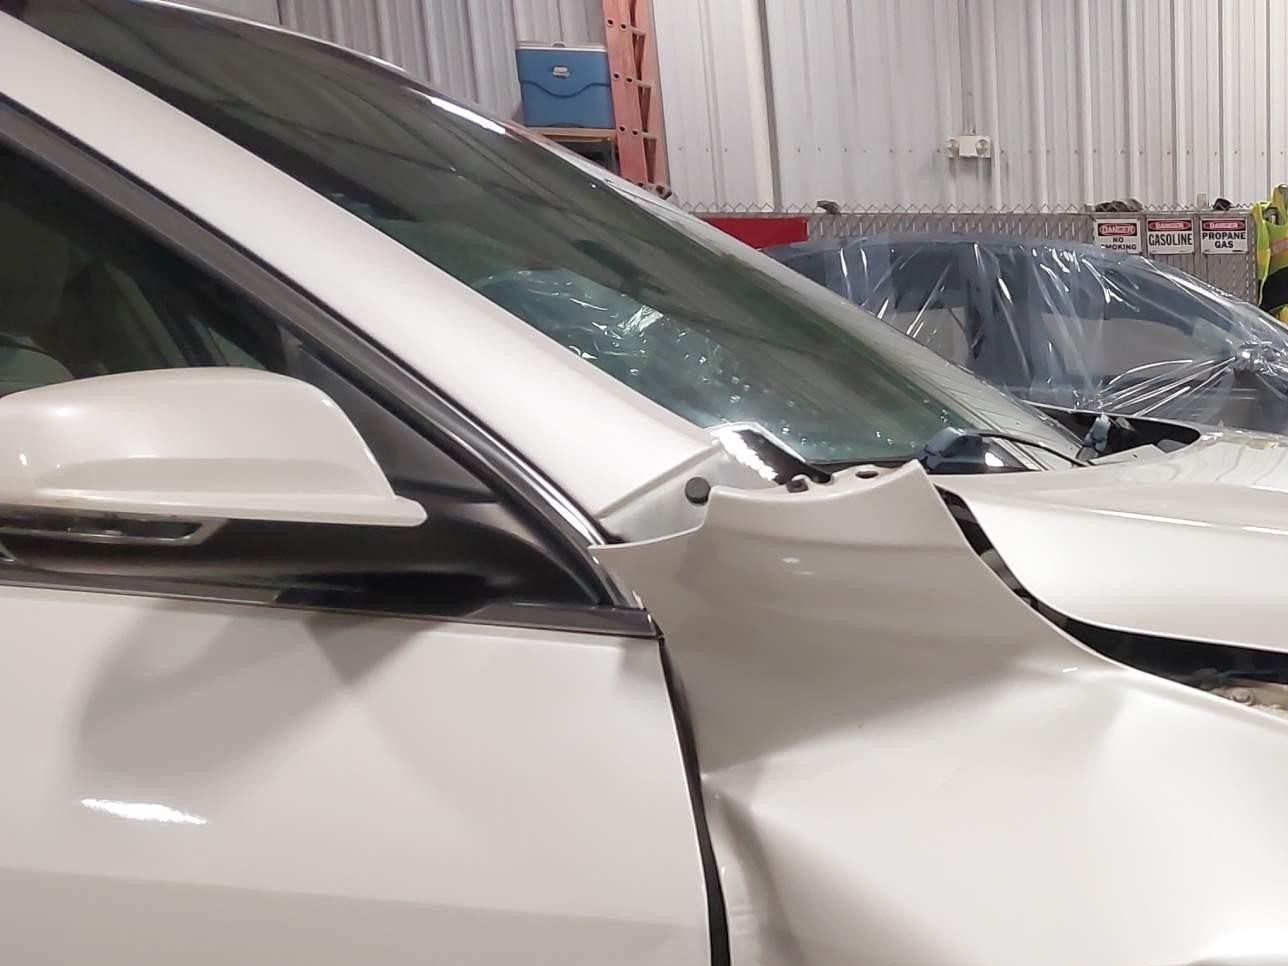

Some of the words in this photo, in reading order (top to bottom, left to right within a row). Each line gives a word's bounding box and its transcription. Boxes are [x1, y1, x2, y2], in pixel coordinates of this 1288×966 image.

[1102, 223, 1134, 233] DANGER
[1148, 233, 1193, 246] GASOLINE
[1202, 232, 1246, 241] PROPANE
[1214, 241, 1234, 249] GAS
